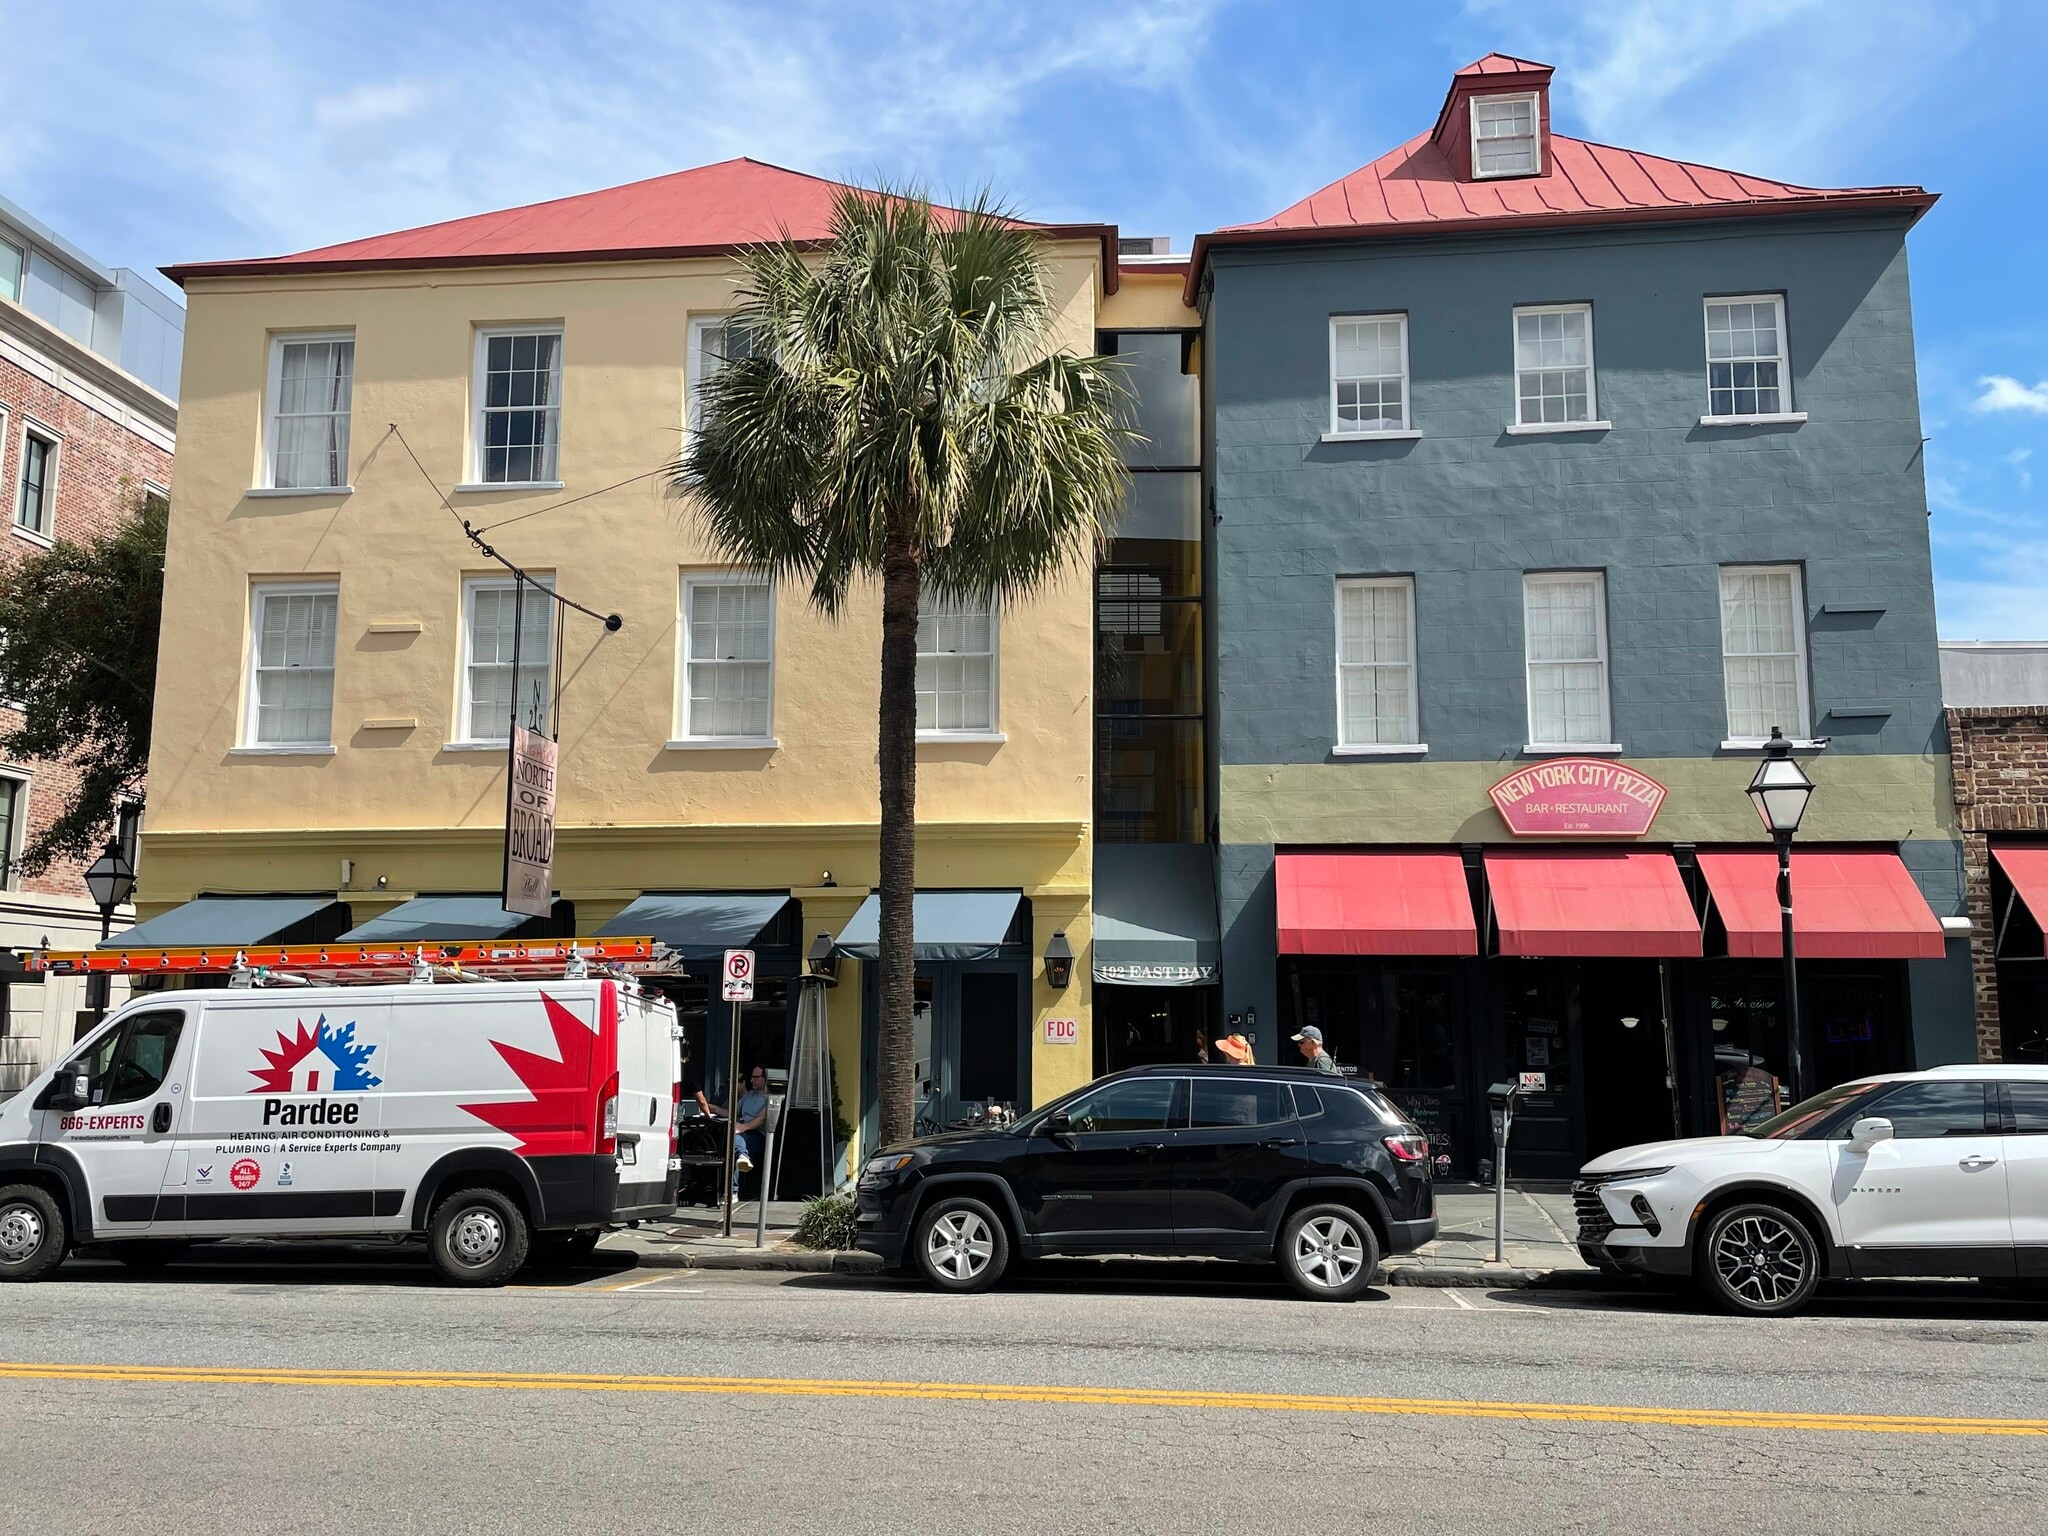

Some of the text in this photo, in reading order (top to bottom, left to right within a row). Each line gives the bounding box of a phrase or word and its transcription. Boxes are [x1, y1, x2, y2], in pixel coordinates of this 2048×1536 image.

[516, 758, 554, 792] NORTH
[1496, 765, 1659, 809] NEW YORK CITY PIZZA
[520, 790, 548, 808] OF
[1525, 803, 1629, 814] BAR RESTAURANT
[512, 807, 552, 864] BROAD
[1129, 966, 1173, 979] EAST
[1178, 966, 1212, 979] BAY
[1048, 1021, 1075, 1037] FDC
[263, 1098, 359, 1126] Pardee
[60, 1115, 145, 1130] 866-EXPERTS
[230, 1130, 390, 1141] HEATING, AIR CONDITIONING &
[215, 1142, 402, 1154] PLUMBING A Service Experts Company
